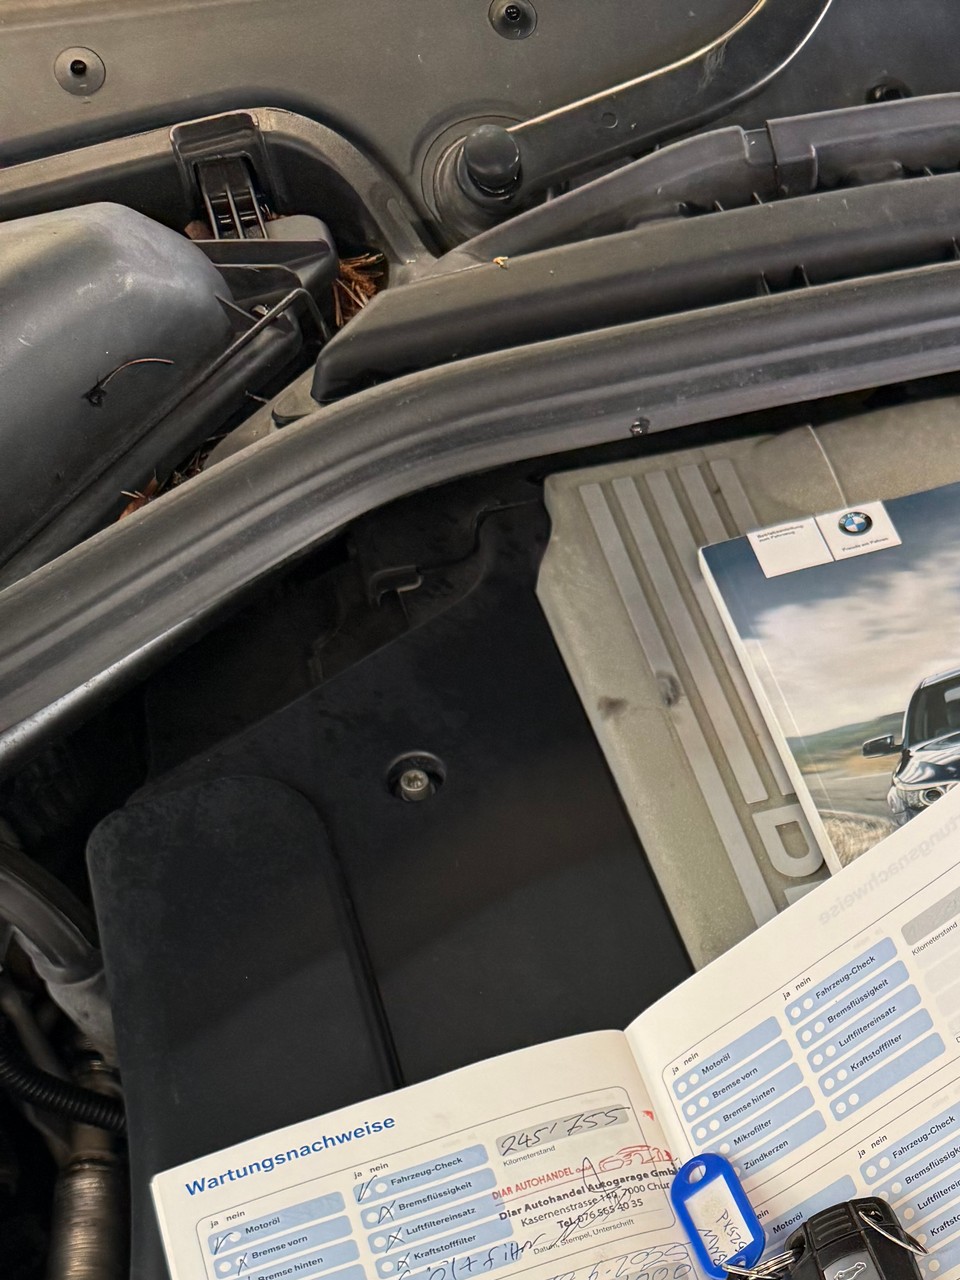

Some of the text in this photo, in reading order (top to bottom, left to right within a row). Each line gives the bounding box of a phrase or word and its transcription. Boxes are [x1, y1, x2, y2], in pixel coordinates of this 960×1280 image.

[912, 922, 958, 956] Kilometerstand
[782, 976, 811, 1000] ja nein
[815, 956, 876, 999] Fahrzeug-Check
[827, 979, 889, 1023] Bremsflüssigkeit
[839, 1005, 897, 1048] Luftfiltereinsatz
[672, 1052, 699, 1075] ja nein
[702, 1053, 731, 1075] Motoröl
[850, 1034, 903, 1071] Kraftstofffilter
[712, 1067, 758, 1099] Bremse vorn
[723, 1086, 776, 1122] Bremse hinten
[733, 1119, 772, 1146] Mikrofilter
[857, 1134, 887, 1158] ja nein
[892, 1116, 956, 1159] Fahrzeug-Check
[185, 1117, 396, 1195] Wartungsnachweise
[503, 1145, 556, 1166] Kilometerstand
[744, 1140, 789, 1170] Zündkerzen
[354, 1162, 388, 1179] ja nein
[391, 1157, 463, 1186] Fahrzeug-Check
[492, 1187, 513, 1200] DIAR
[515, 1167, 574, 1191] AUTOHANDEL
[399, 1181, 472, 1210] Bremsflüssigkeit
[499, 1207, 522, 1220] Diar
[525, 1186, 585, 1212] Autohandel
[588, 1172, 649, 1192] Autogarage
[521, 1197, 598, 1227] Kasernenstrasse
[647, 1181, 669, 1191] Chur
[210, 1210, 245, 1229] ja nein
[406, 1207, 476, 1235] Luftfiltereinsatz
[577, 1211, 596, 1223] 076
[617, 1202, 630, 1212] 40
[632, 1199, 643, 1209] 35
[772, 1212, 803, 1234] Motoröl
[245, 1217, 281, 1234] Motoröl
[561, 1231, 593, 1246] Stempel,
[593, 1219, 634, 1235] Unterschrift
[252, 1236, 308, 1259] Bremse vorn
[414, 1235, 476, 1260] Kraftstofffilter
[294, 1257, 323, 1272] hinten
